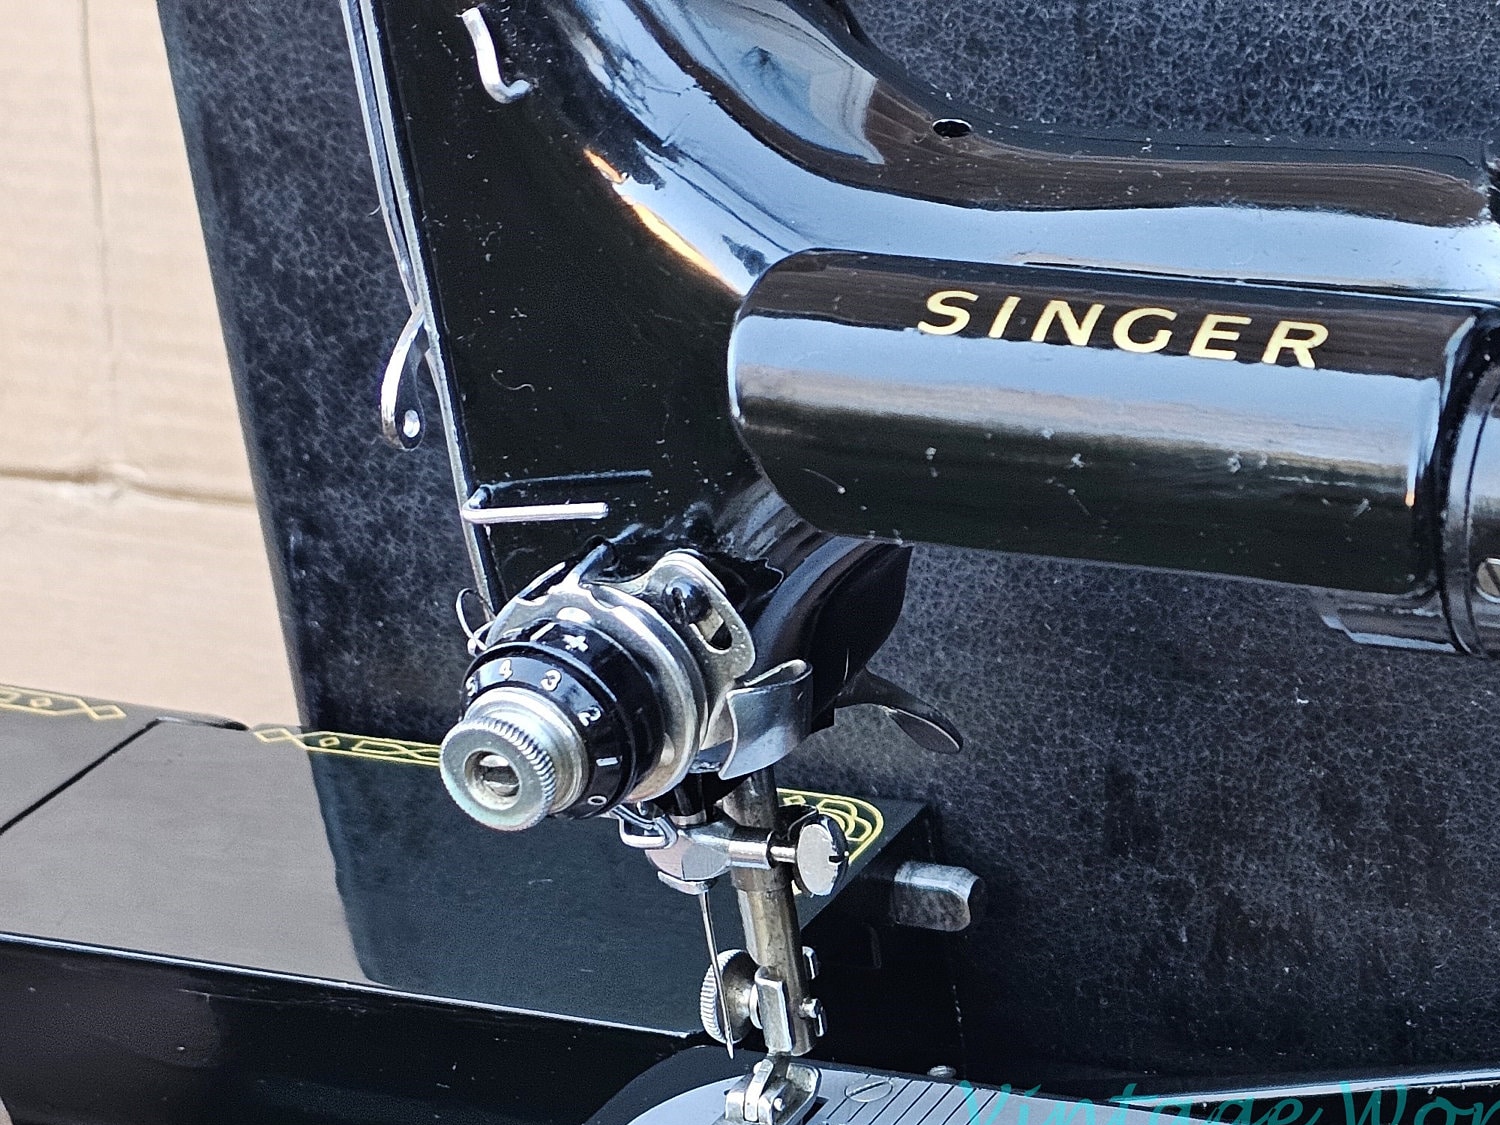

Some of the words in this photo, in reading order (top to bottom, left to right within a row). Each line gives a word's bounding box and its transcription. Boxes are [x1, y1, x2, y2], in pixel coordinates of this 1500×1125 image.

[917, 290, 1330, 370] SINGER
[499, 659, 513, 681] 4
[541, 669, 563, 692] 3
[578, 705, 602, 727] 2
